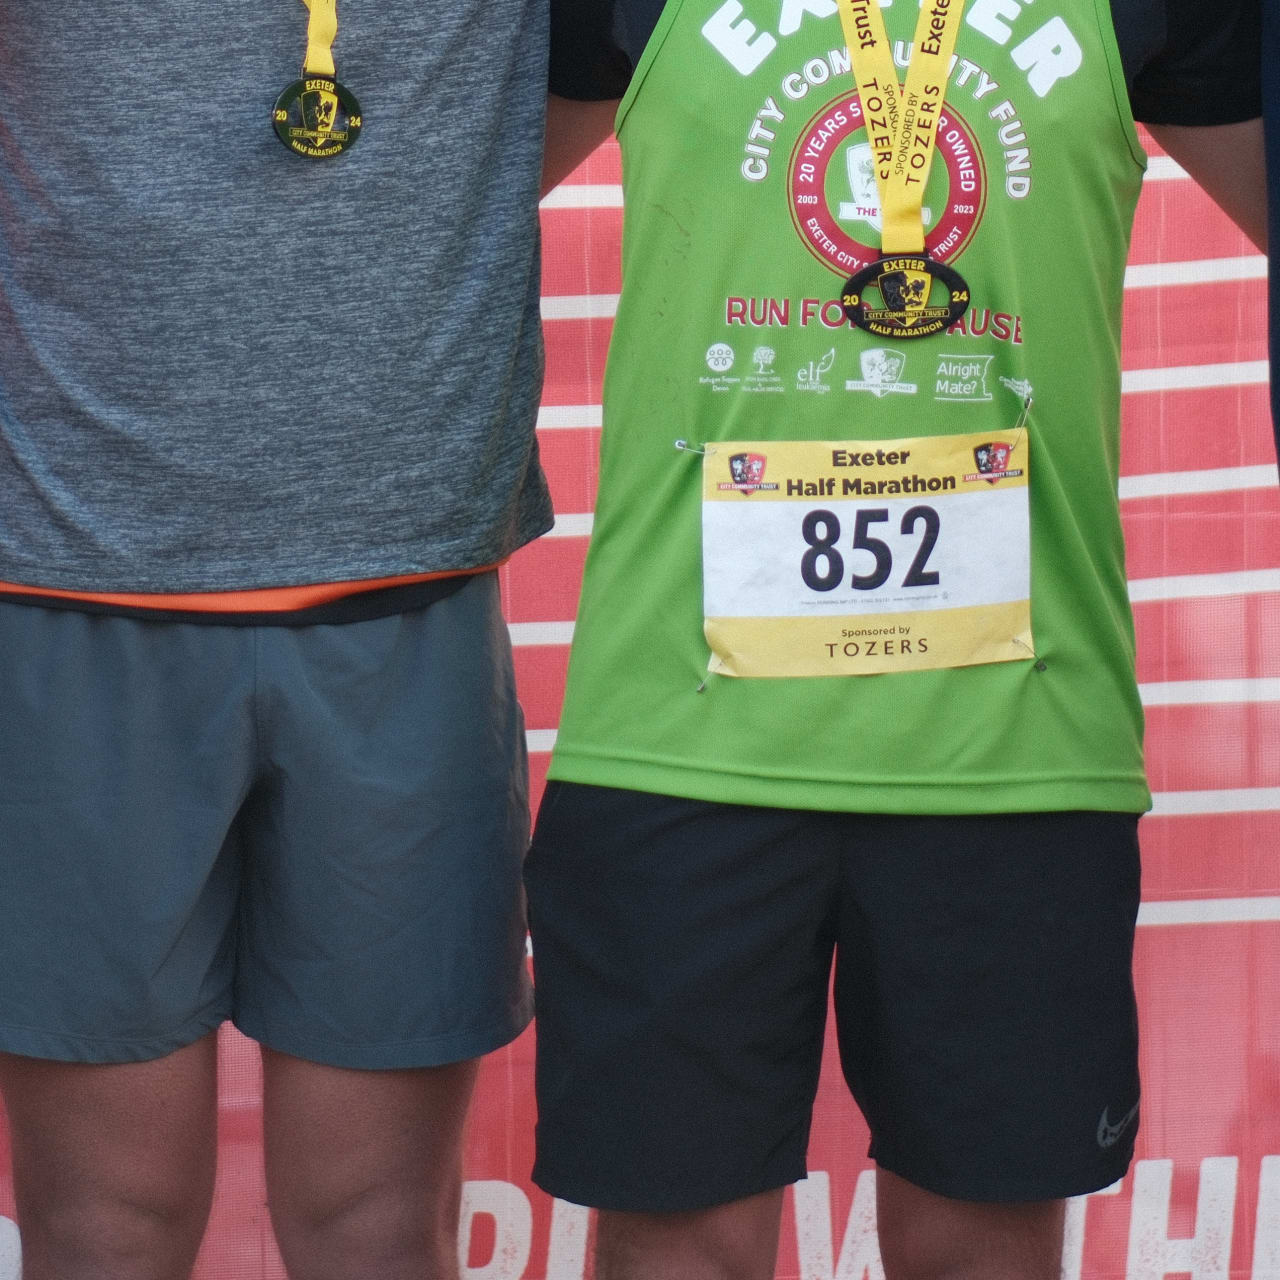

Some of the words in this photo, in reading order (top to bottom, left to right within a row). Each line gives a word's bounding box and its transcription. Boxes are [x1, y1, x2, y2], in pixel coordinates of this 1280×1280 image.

[305, 80, 335, 92] EXETER
[276, 110, 287, 120] 20
[350, 116, 361, 126] 24
[805, 111, 847, 160] YEARS
[895, 108, 916, 175] SPONSORED
[908, 92, 919, 106] BY
[905, 84, 940, 186] TOZERS
[292, 140, 307, 152] HALF
[308, 144, 342, 155] MARATHON
[741, 96, 786, 183] CITY
[988, 99, 1032, 200] FUND
[946, 130, 976, 192] OWNED
[799, 163, 815, 183] 20
[797, 195, 818, 204] 2003
[856, 207, 877, 217] THE
[953, 205, 974, 214] 2023
[807, 218, 838, 255] EXETER
[837, 252, 860, 269] CITY
[933, 225, 963, 257] TRUST
[883, 260, 926, 272] EXETER
[843, 295, 859, 306] 20
[952, 291, 968, 302] 24
[726, 297, 790, 326] RUN
[884, 311, 924, 319] COMMUNITY
[869, 322, 892, 335] HALF
[893, 320, 943, 336] MARATHON
[946, 308, 1023, 344] AUSE
[936, 362, 981, 379] Alright
[936, 380, 977, 394] Mate?
[832, 449, 910, 467] Exeter
[787, 478, 836, 496] Half
[843, 474, 956, 496] Marathon
[800, 505, 941, 592] 852
[842, 626, 896, 638] Sponsored
[899, 626, 911, 636] by
[825, 638, 928, 658] TOZERS
